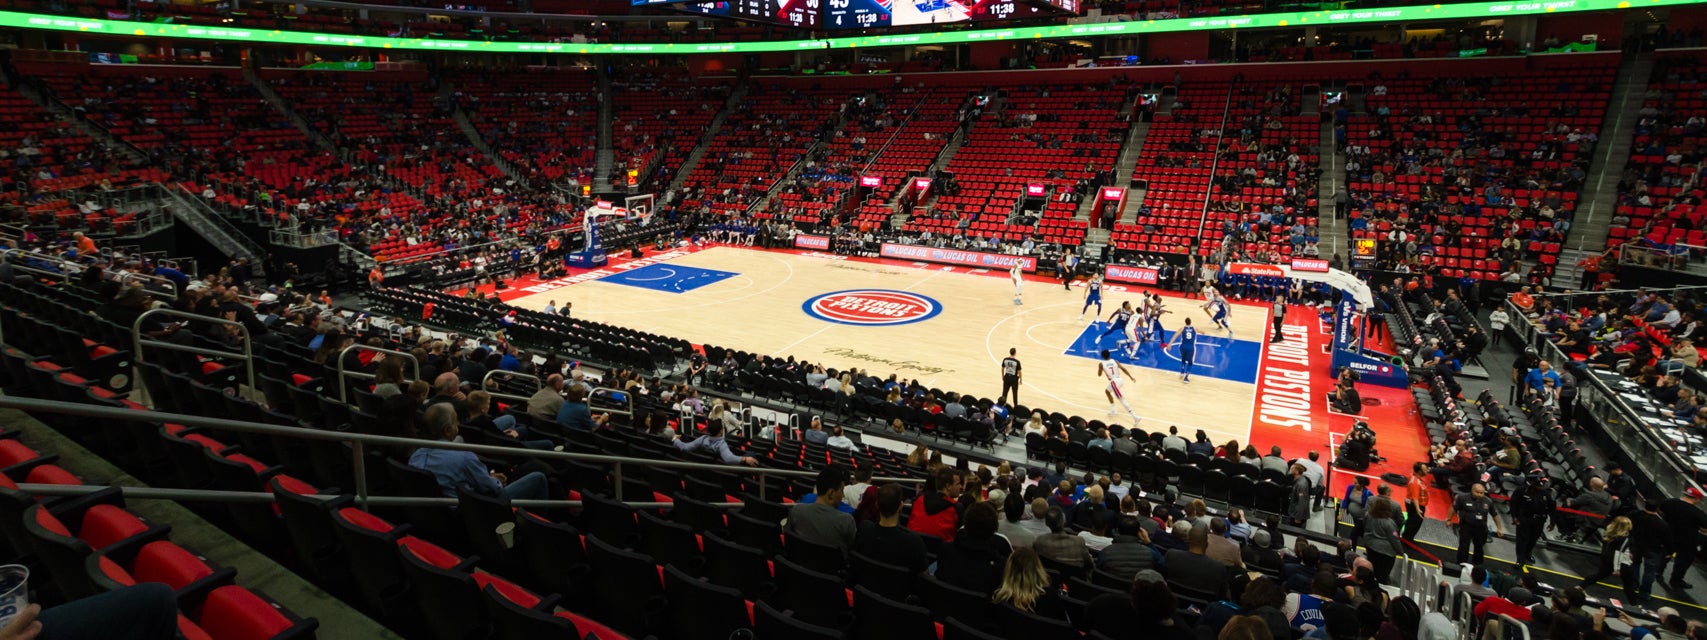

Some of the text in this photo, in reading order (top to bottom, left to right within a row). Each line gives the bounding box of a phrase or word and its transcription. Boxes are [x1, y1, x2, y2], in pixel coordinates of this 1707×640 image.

[990, 3, 1015, 14] 11:38
[1489, 0, 1576, 13] OBEY YOUR THIRST
[857, 13, 878, 24] 11:38
[1374, 10, 1402, 18] THIRST
[836, 15, 842, 25] 4
[803, 238, 828, 247] LUCAS OIL
[894, 247, 927, 258] LUCAS OIL
[942, 251, 977, 263] LUCAS OIL
[1301, 261, 1327, 270] LUCAS OIL
[1118, 269, 1155, 280] LUCAS OIL
[828, 300, 906, 317] PISTONS
[844, 296, 917, 310] DETROIT
[1340, 317, 1348, 343] VISION
[1186, 332, 1192, 340] 9
[1108, 366, 1115, 375] 7
[1350, 362, 1378, 372] BELFOR
[1259, 323, 1312, 432] DETROIT PISTONS
